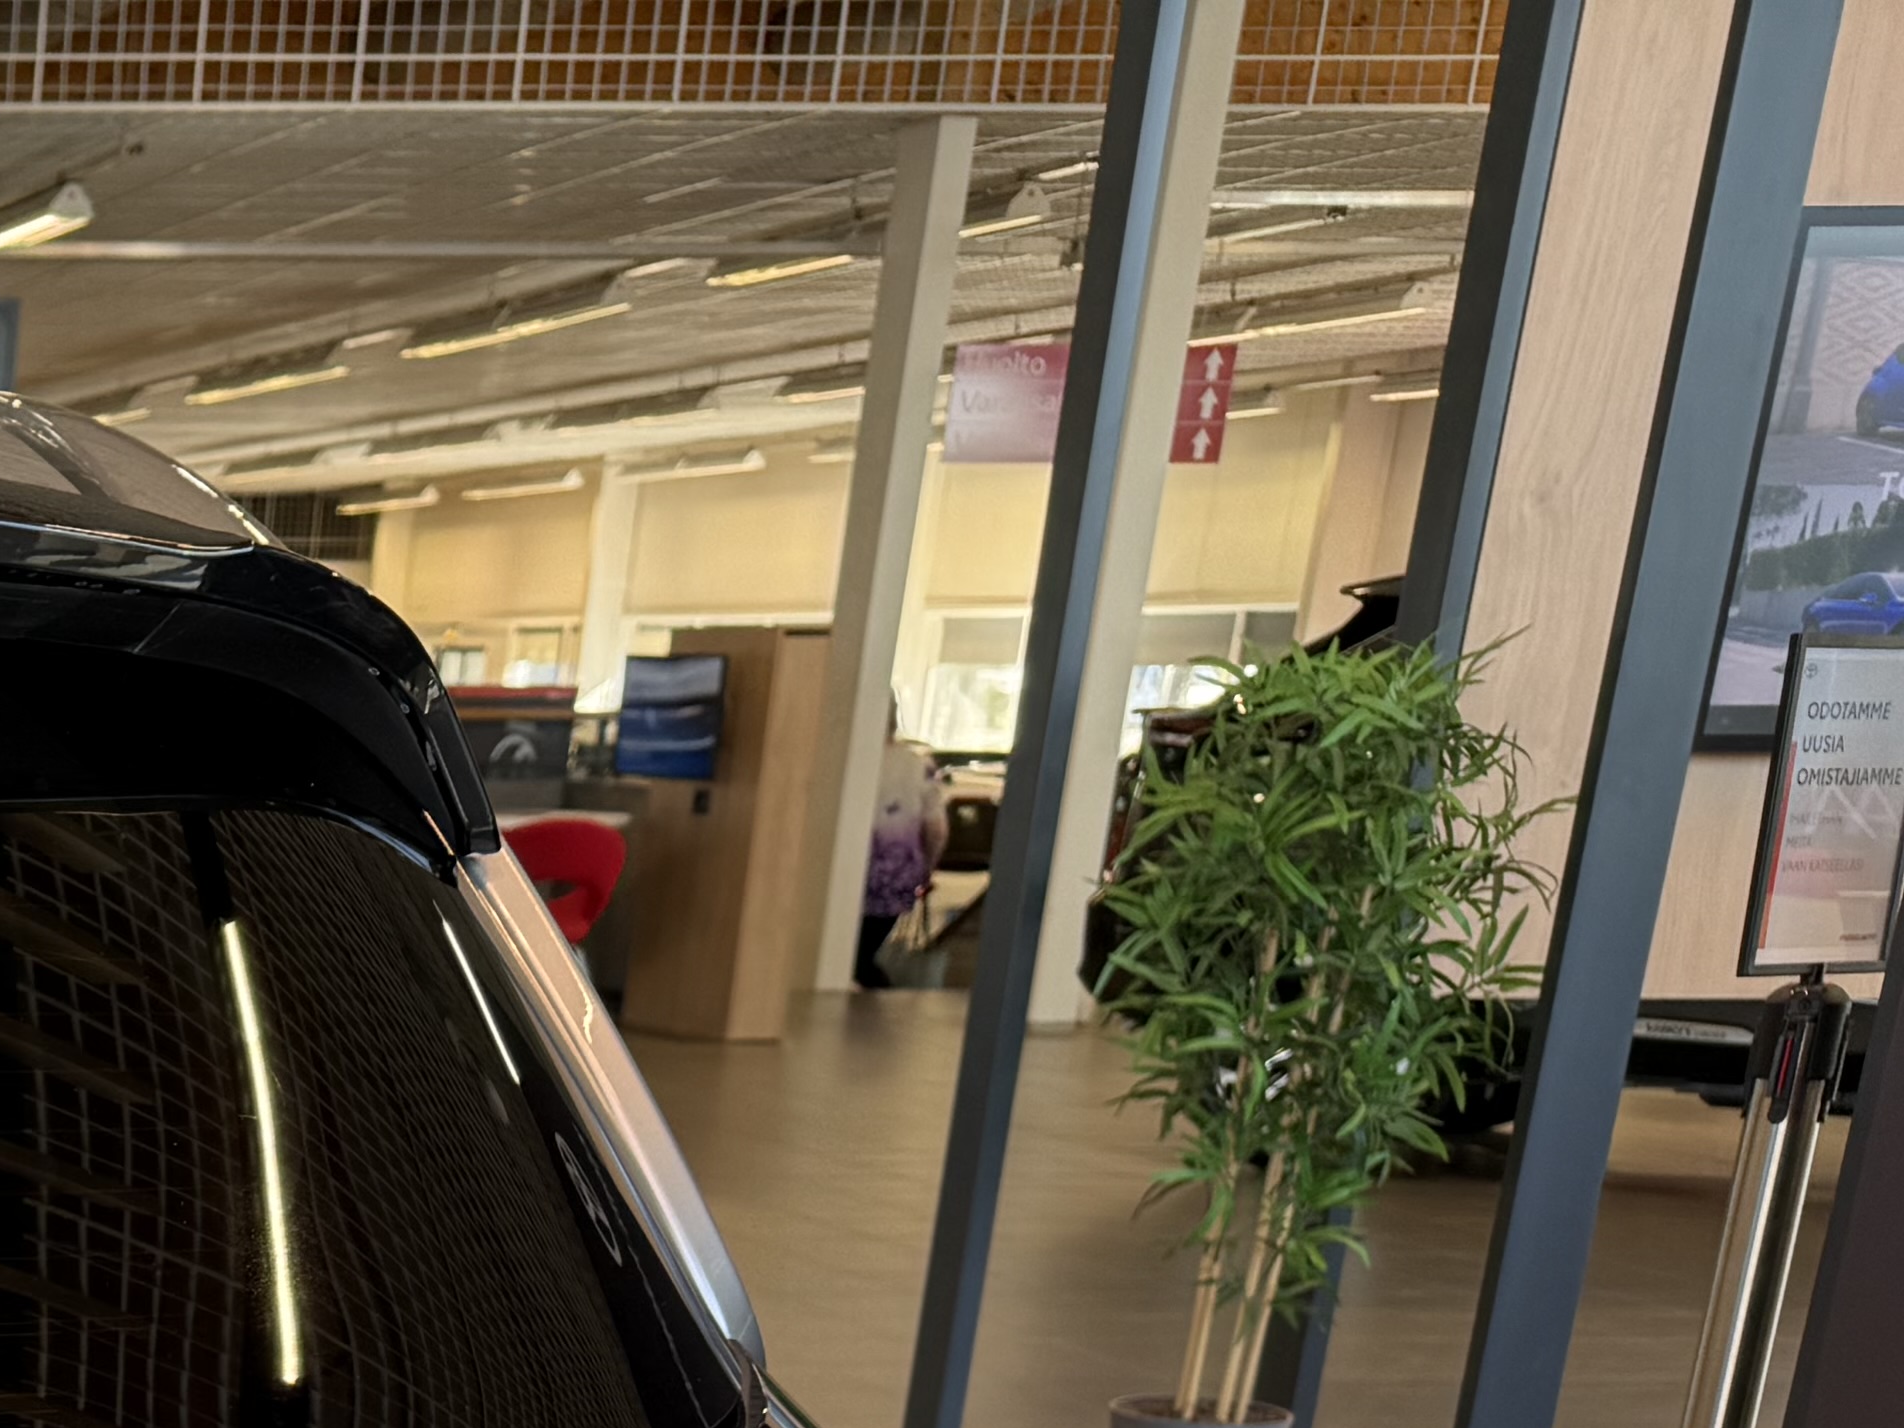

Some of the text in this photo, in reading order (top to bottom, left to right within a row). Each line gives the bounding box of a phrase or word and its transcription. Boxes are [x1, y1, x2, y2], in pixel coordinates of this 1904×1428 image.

[1807, 701, 1892, 720] ODOTAMME
[1802, 735, 1845, 753] UUSIA
[1797, 767, 1903, 786] OMISTAJIAMME
